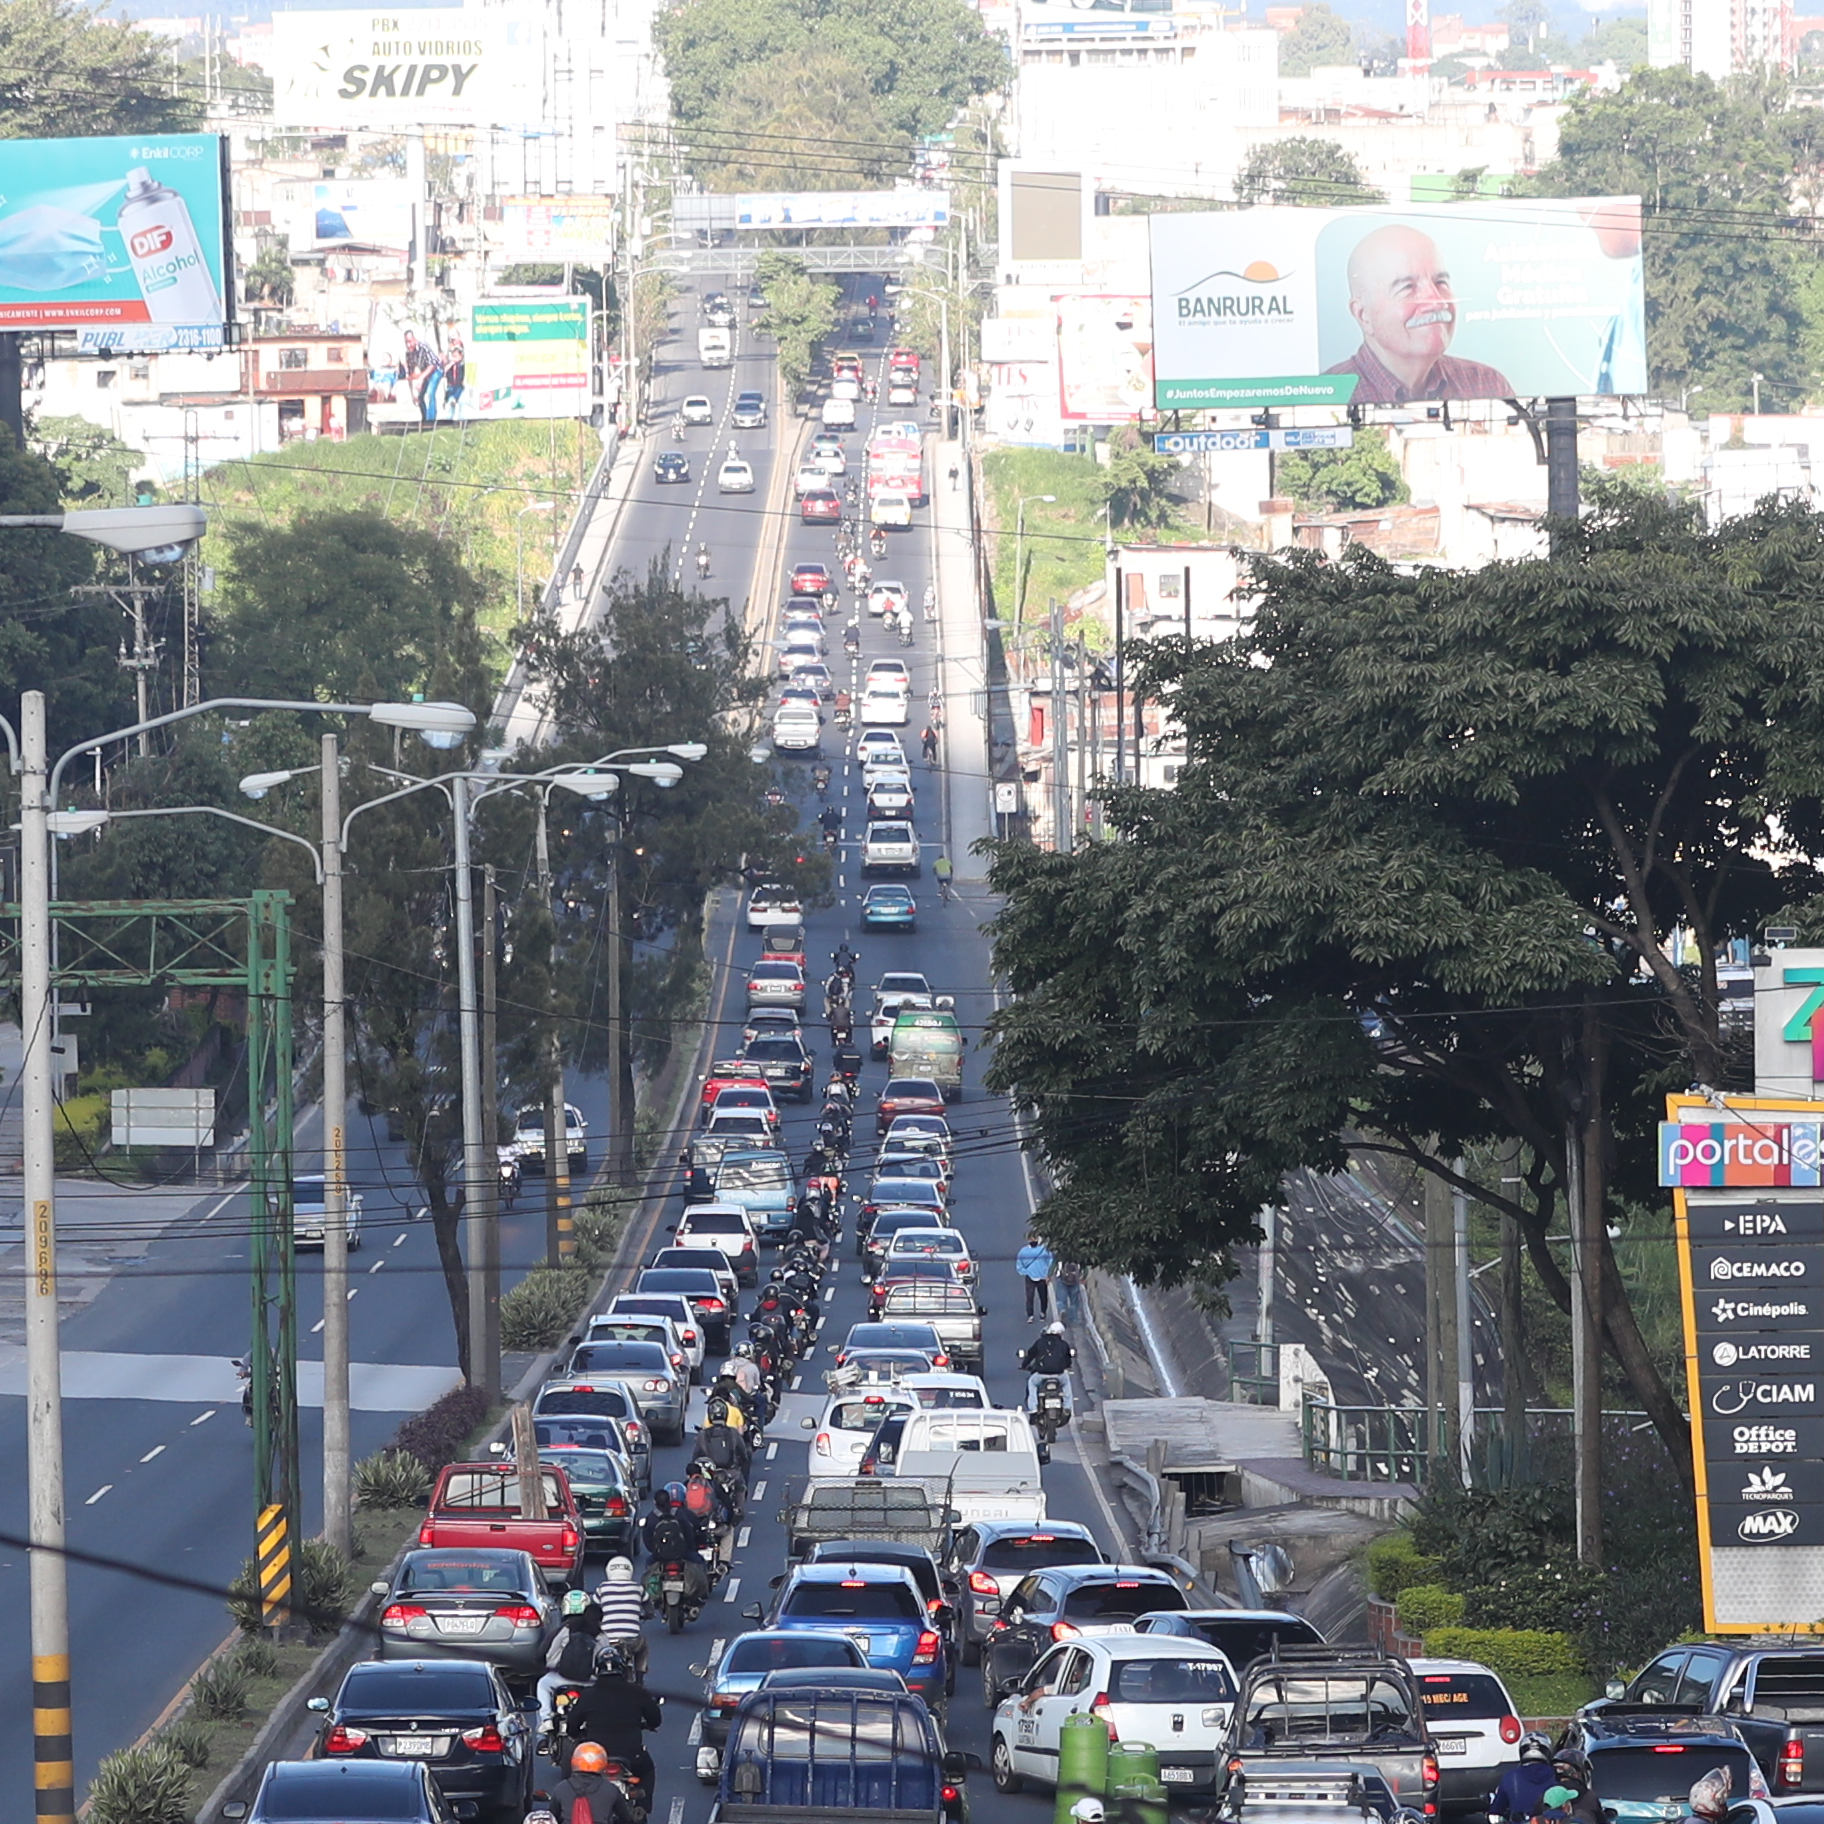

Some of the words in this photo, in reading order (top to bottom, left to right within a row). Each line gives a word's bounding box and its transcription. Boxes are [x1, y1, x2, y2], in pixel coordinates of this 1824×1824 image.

[372, 18, 400, 32] PBX
[372, 41, 413, 57] AUTO
[417, 40, 483, 56] VIDRIOS
[337, 63, 480, 100] SKIPY
[133, 228, 171, 257] DIF
[142, 250, 201, 284] Alcohol
[1178, 295, 1294, 319] BANRURAL
[178, 327, 221, 347] 2316-1100
[1166, 386, 1334, 401] #JuntosEmpezaremosDeNuevo
[1739, 1214, 1787, 1235] EPA
[1732, 1262, 1806, 1277] CEMACO
[1736, 1302, 1807, 1319] Cinépolis
[1739, 1345, 1811, 1359] LATORRE
[1756, 1384, 1815, 1403] CIAM
[1733, 1425, 1797, 1441] Office
[1743, 1511, 1794, 1534] MAX
